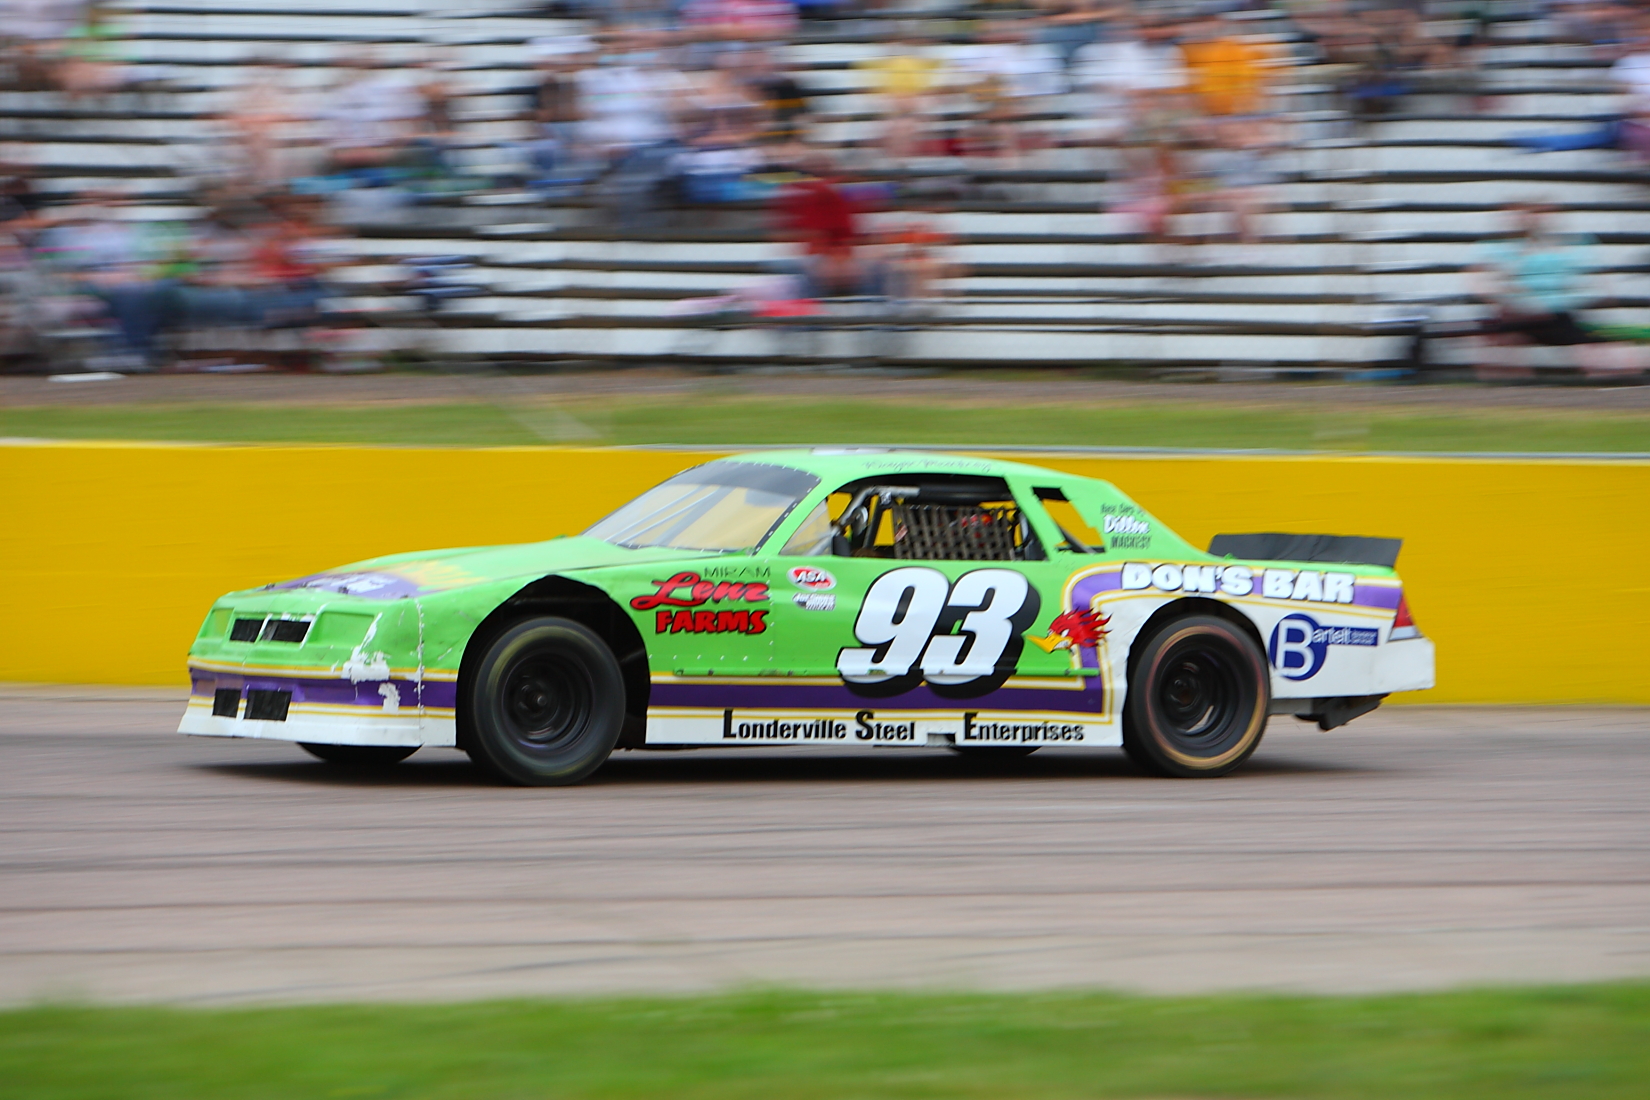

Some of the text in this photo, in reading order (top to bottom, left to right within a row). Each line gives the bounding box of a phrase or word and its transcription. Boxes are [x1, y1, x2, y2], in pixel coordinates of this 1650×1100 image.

[795, 569, 828, 584] ASA
[1121, 561, 1355, 604] DON'S BAR
[655, 609, 770, 635] FARMS
[836, 565, 1031, 699] 93
[722, 708, 1085, 743] Londerville Steel Enterprises
